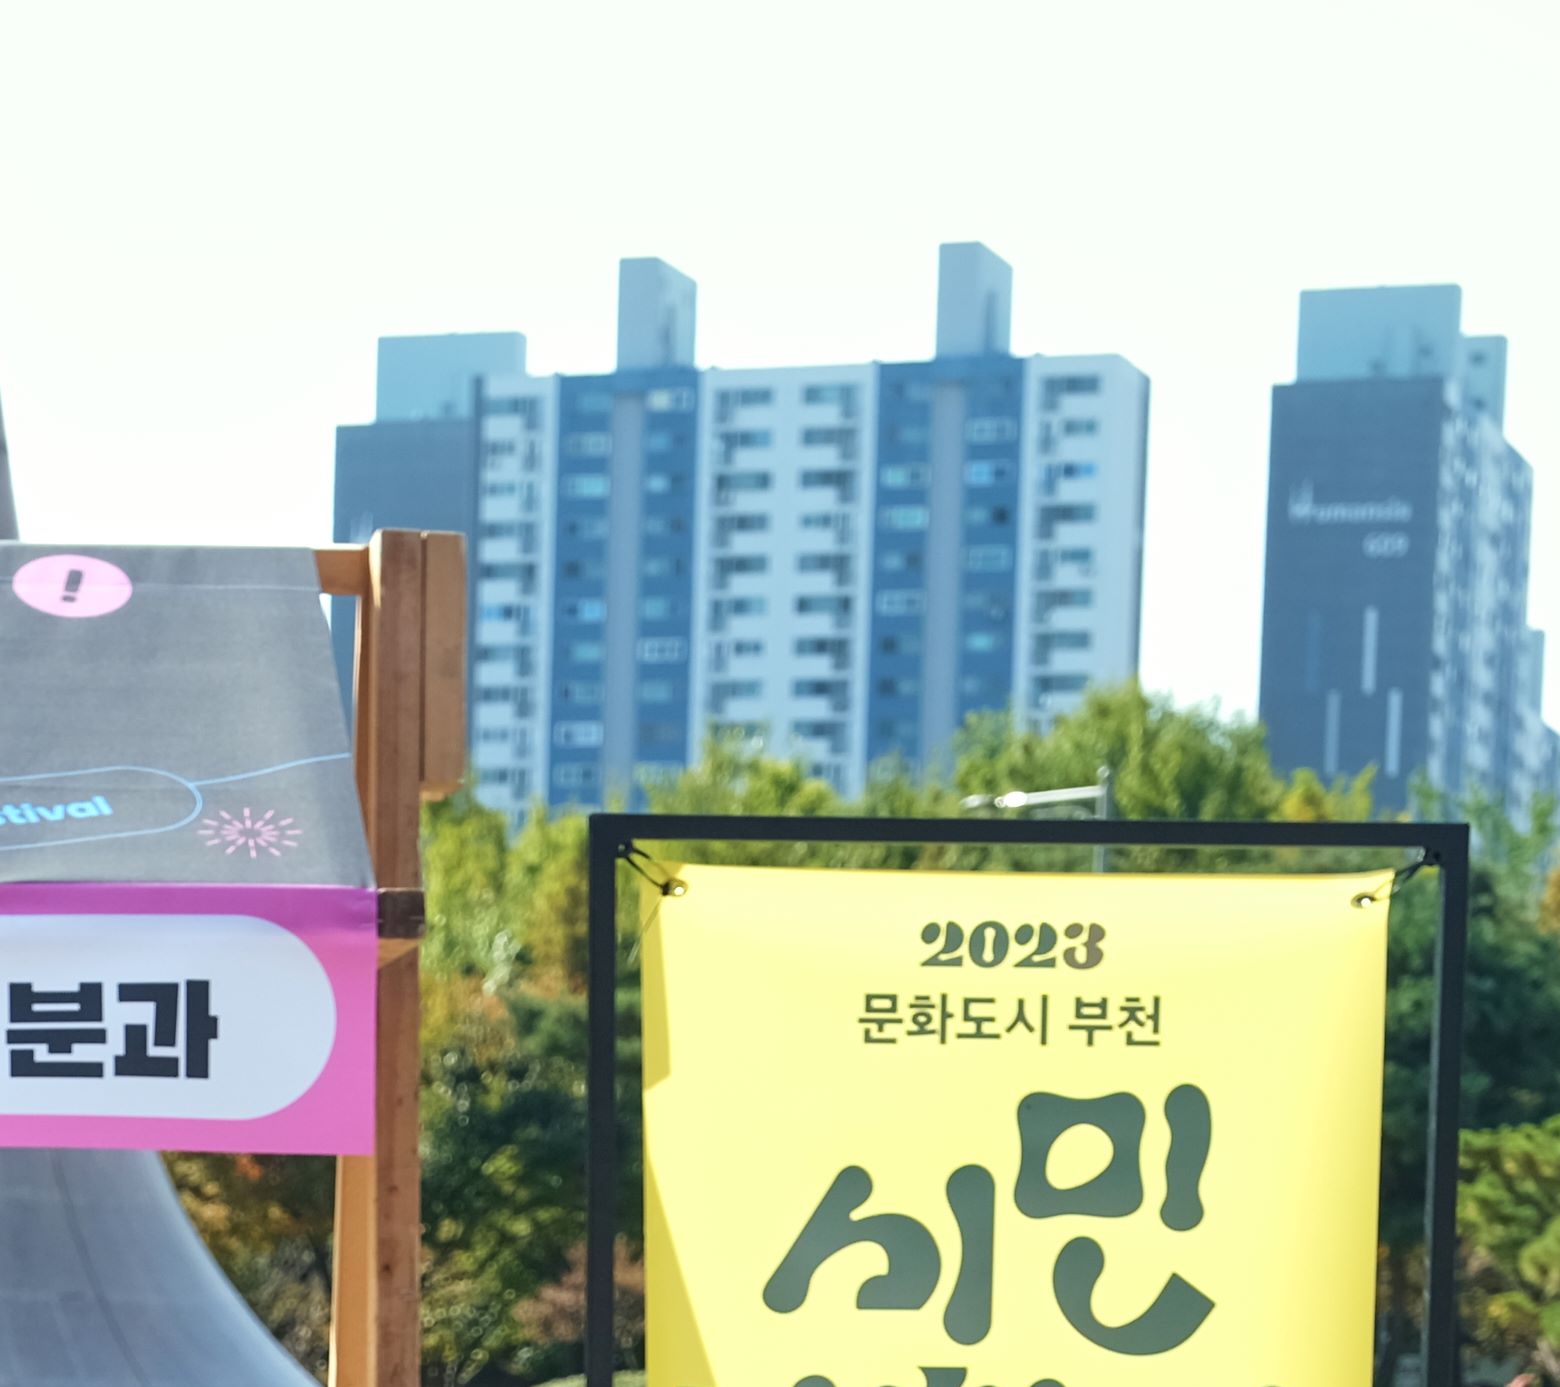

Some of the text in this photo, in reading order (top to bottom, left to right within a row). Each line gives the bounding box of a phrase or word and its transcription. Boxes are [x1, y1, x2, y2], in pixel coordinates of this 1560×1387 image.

[919, 920, 1107, 970] 2023
[857, 992, 1162, 1047] 문화도시 부천
[761, 1082, 1216, 1357] 시민
